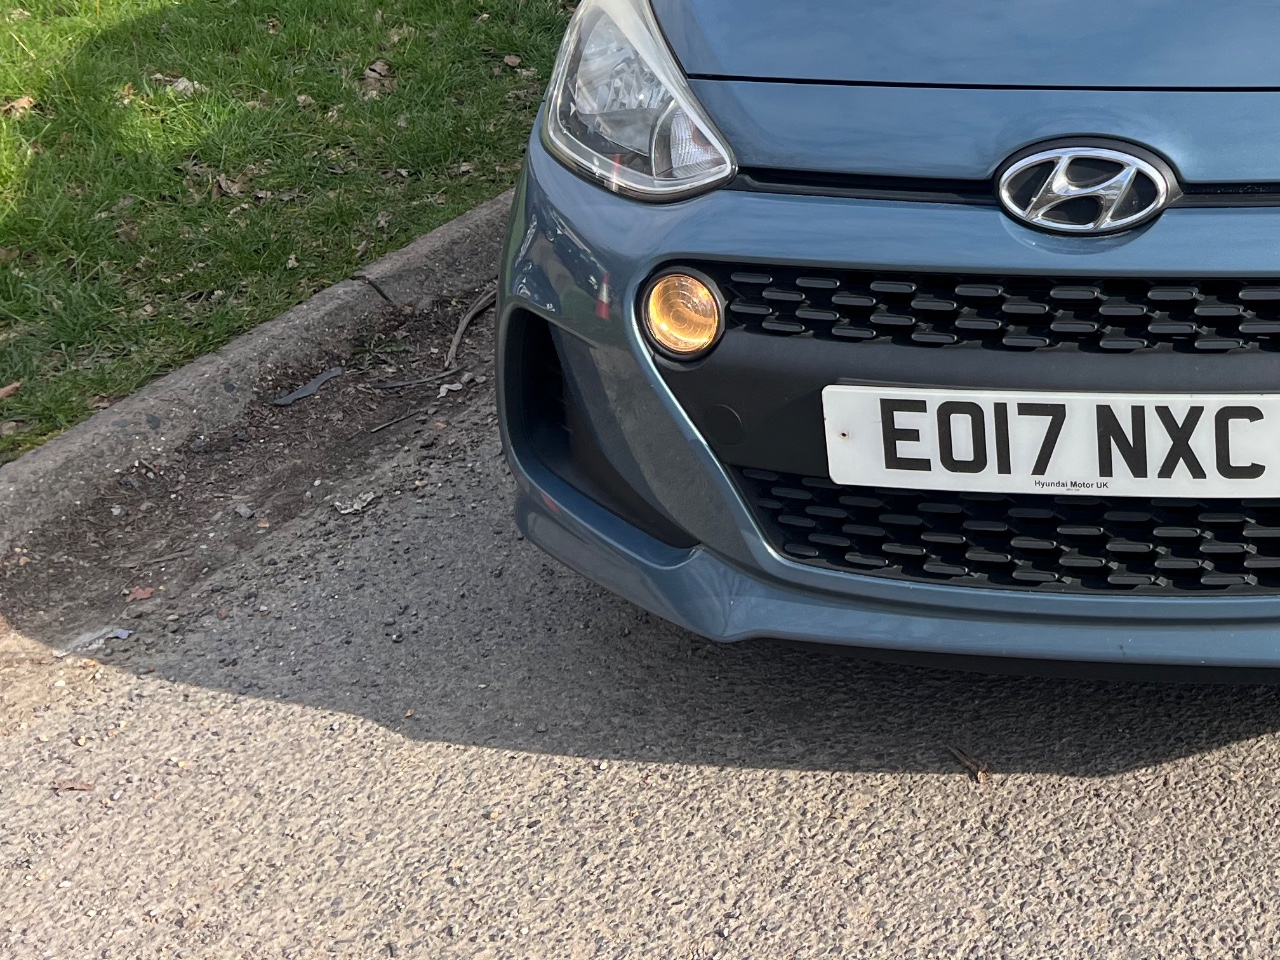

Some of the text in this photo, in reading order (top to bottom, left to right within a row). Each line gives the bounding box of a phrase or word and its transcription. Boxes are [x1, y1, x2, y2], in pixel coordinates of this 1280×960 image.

[879, 397, 1266, 480] EO17 NXC
[1034, 480, 1068, 489] Hyundai
[1070, 481, 1094, 489] Motor
